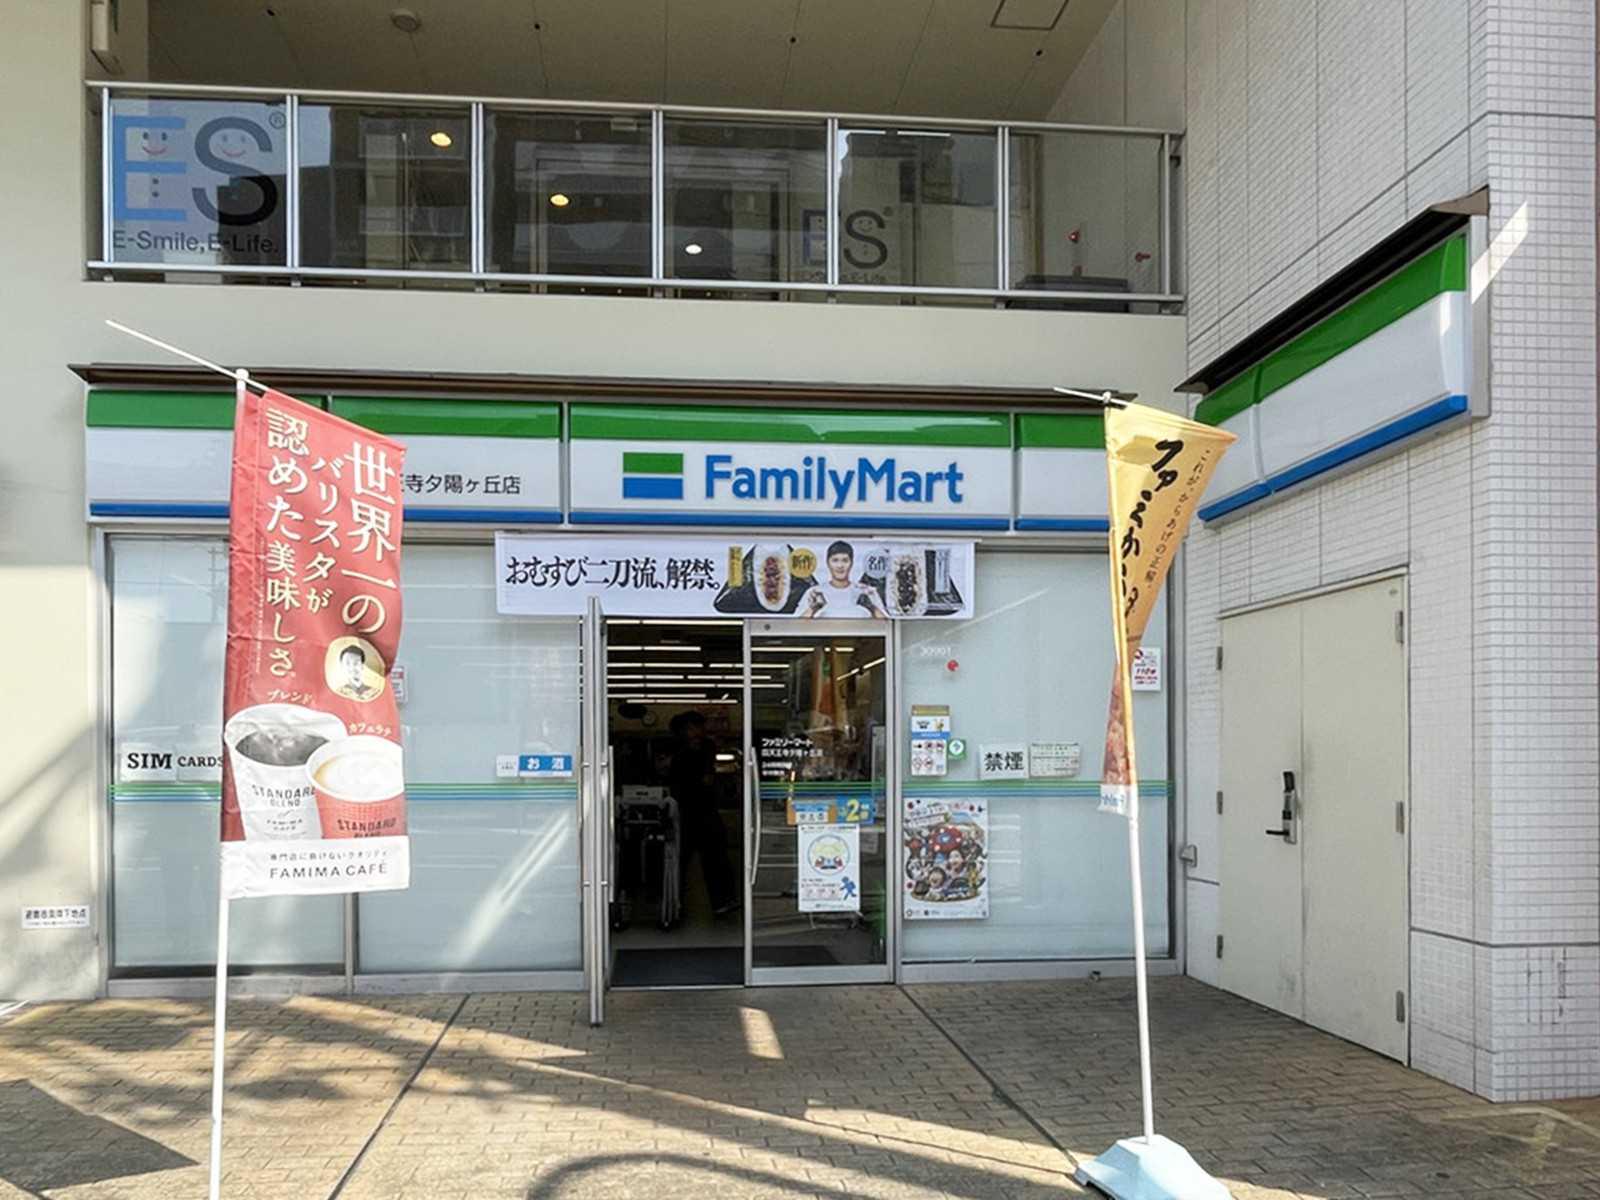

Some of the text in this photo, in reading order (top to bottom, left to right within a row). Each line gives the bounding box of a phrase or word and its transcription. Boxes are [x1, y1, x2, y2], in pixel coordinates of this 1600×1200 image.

[401, 473, 521, 495] 寺夕陽ヶ丘店
[705, 455, 963, 509] FamilyMart
[302, 457, 345, 614] バリスタが
[341, 441, 398, 633] 世界一の
[505, 555, 720, 591] おむすび二刀流、解禁。
[349, 723, 392, 737] カフェラテ
[127, 752, 173, 769] SIM
[527, 757, 565, 770] お酒
[984, 751, 1025, 771] 禁煙
[270, 859, 388, 879] FAMIMA CAFÉ
